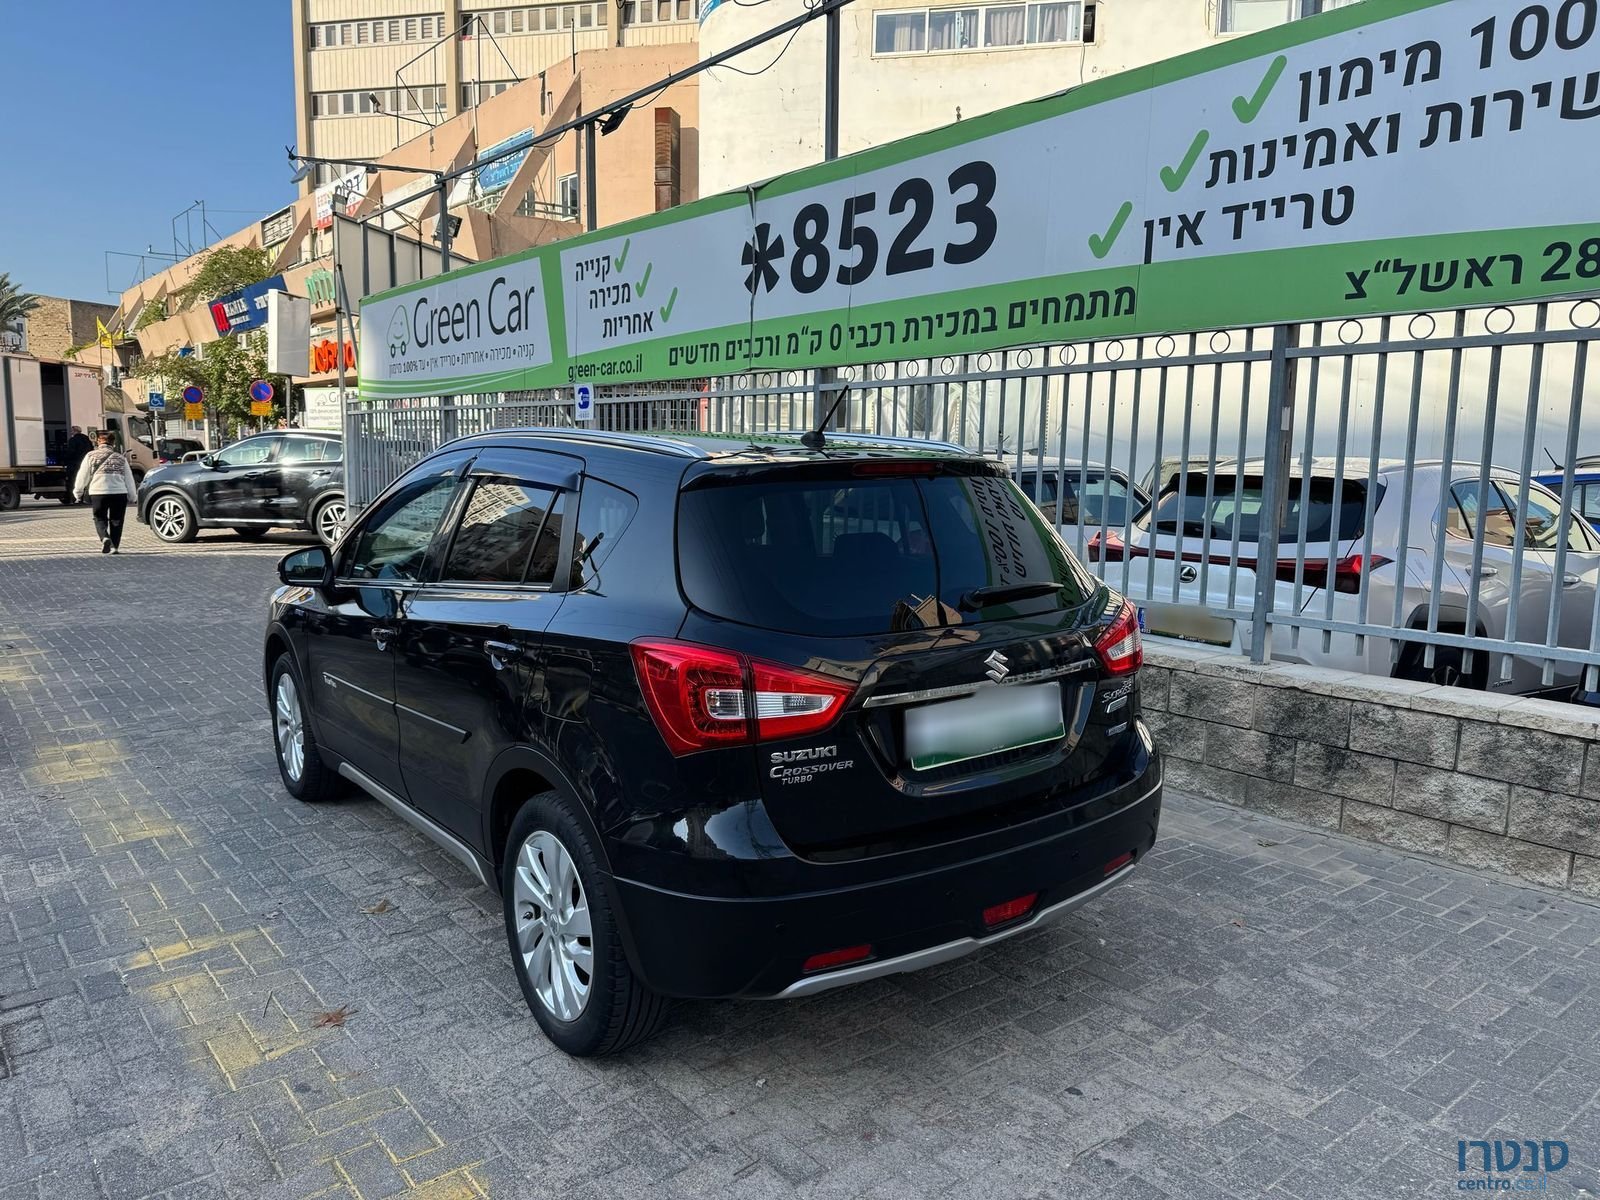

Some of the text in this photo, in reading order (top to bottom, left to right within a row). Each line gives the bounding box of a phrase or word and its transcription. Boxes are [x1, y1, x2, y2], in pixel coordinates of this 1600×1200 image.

[1299, 40, 1442, 123] מימון
[1205, 71, 1600, 189] שירות ואמינות
[1143, 185, 1355, 265] טרייד אין
[575, 255, 611, 283] קנייה
[1540, 237, 1600, 282] 28
[589, 282, 631, 310] מכירה
[1007, 287, 1136, 330] מתמחים
[413, 277, 535, 348] Green Car
[602, 311, 654, 339] אחריות
[902, 306, 998, 343] במכירת
[725, 335, 780, 361] ורכבים
[848, 321, 895, 349] רכבי
[461, 350, 485, 365] אחריות
[490, 346, 511, 361] מכירה
[517, 343, 535, 360] קניה
[669, 343, 720, 366] חדשים
[403, 361, 418, 373] 100%
[568, 353, 643, 383] green-car.co.il
[770, 744, 838, 764] SUZUKI
[781, 774, 814, 786] TURBO
